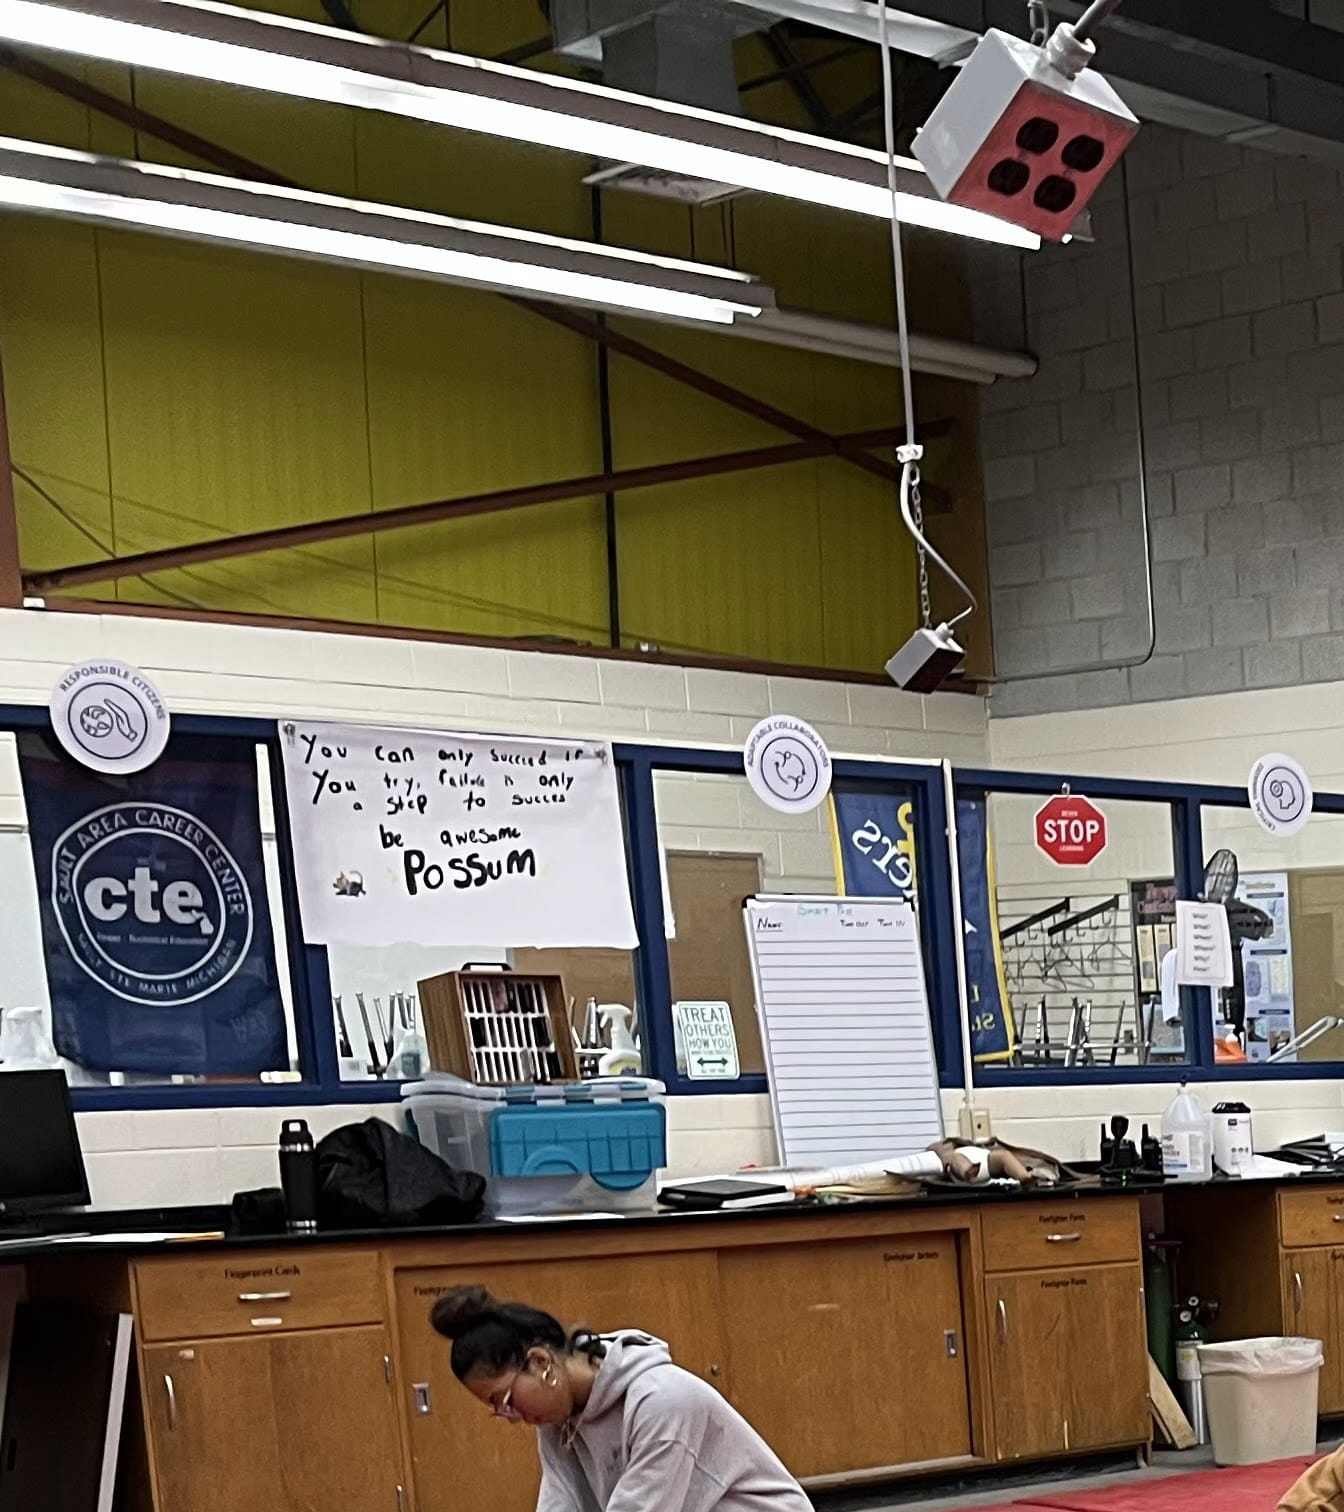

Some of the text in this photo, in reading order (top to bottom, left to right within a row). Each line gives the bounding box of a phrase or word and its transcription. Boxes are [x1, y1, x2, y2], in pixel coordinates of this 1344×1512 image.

[59, 666, 166, 720] RESPONSIBLE CITIZENS
[300, 734, 348, 764] You
[438, 749, 474, 767] only
[312, 769, 357, 805] You
[538, 772, 574, 791] only
[463, 791, 486, 812] to
[379, 824, 522, 849] be awesome
[1044, 819, 1100, 843] STOP
[76, 813, 128, 848] AREA
[135, 809, 204, 845] CAREER
[205, 844, 245, 915] CENTER
[84, 867, 204, 925] cte
[682, 1008, 724, 1022] TREAT
[686, 1024, 729, 1037] OTHERS
[689, 1039, 731, 1048] HOW YOU
